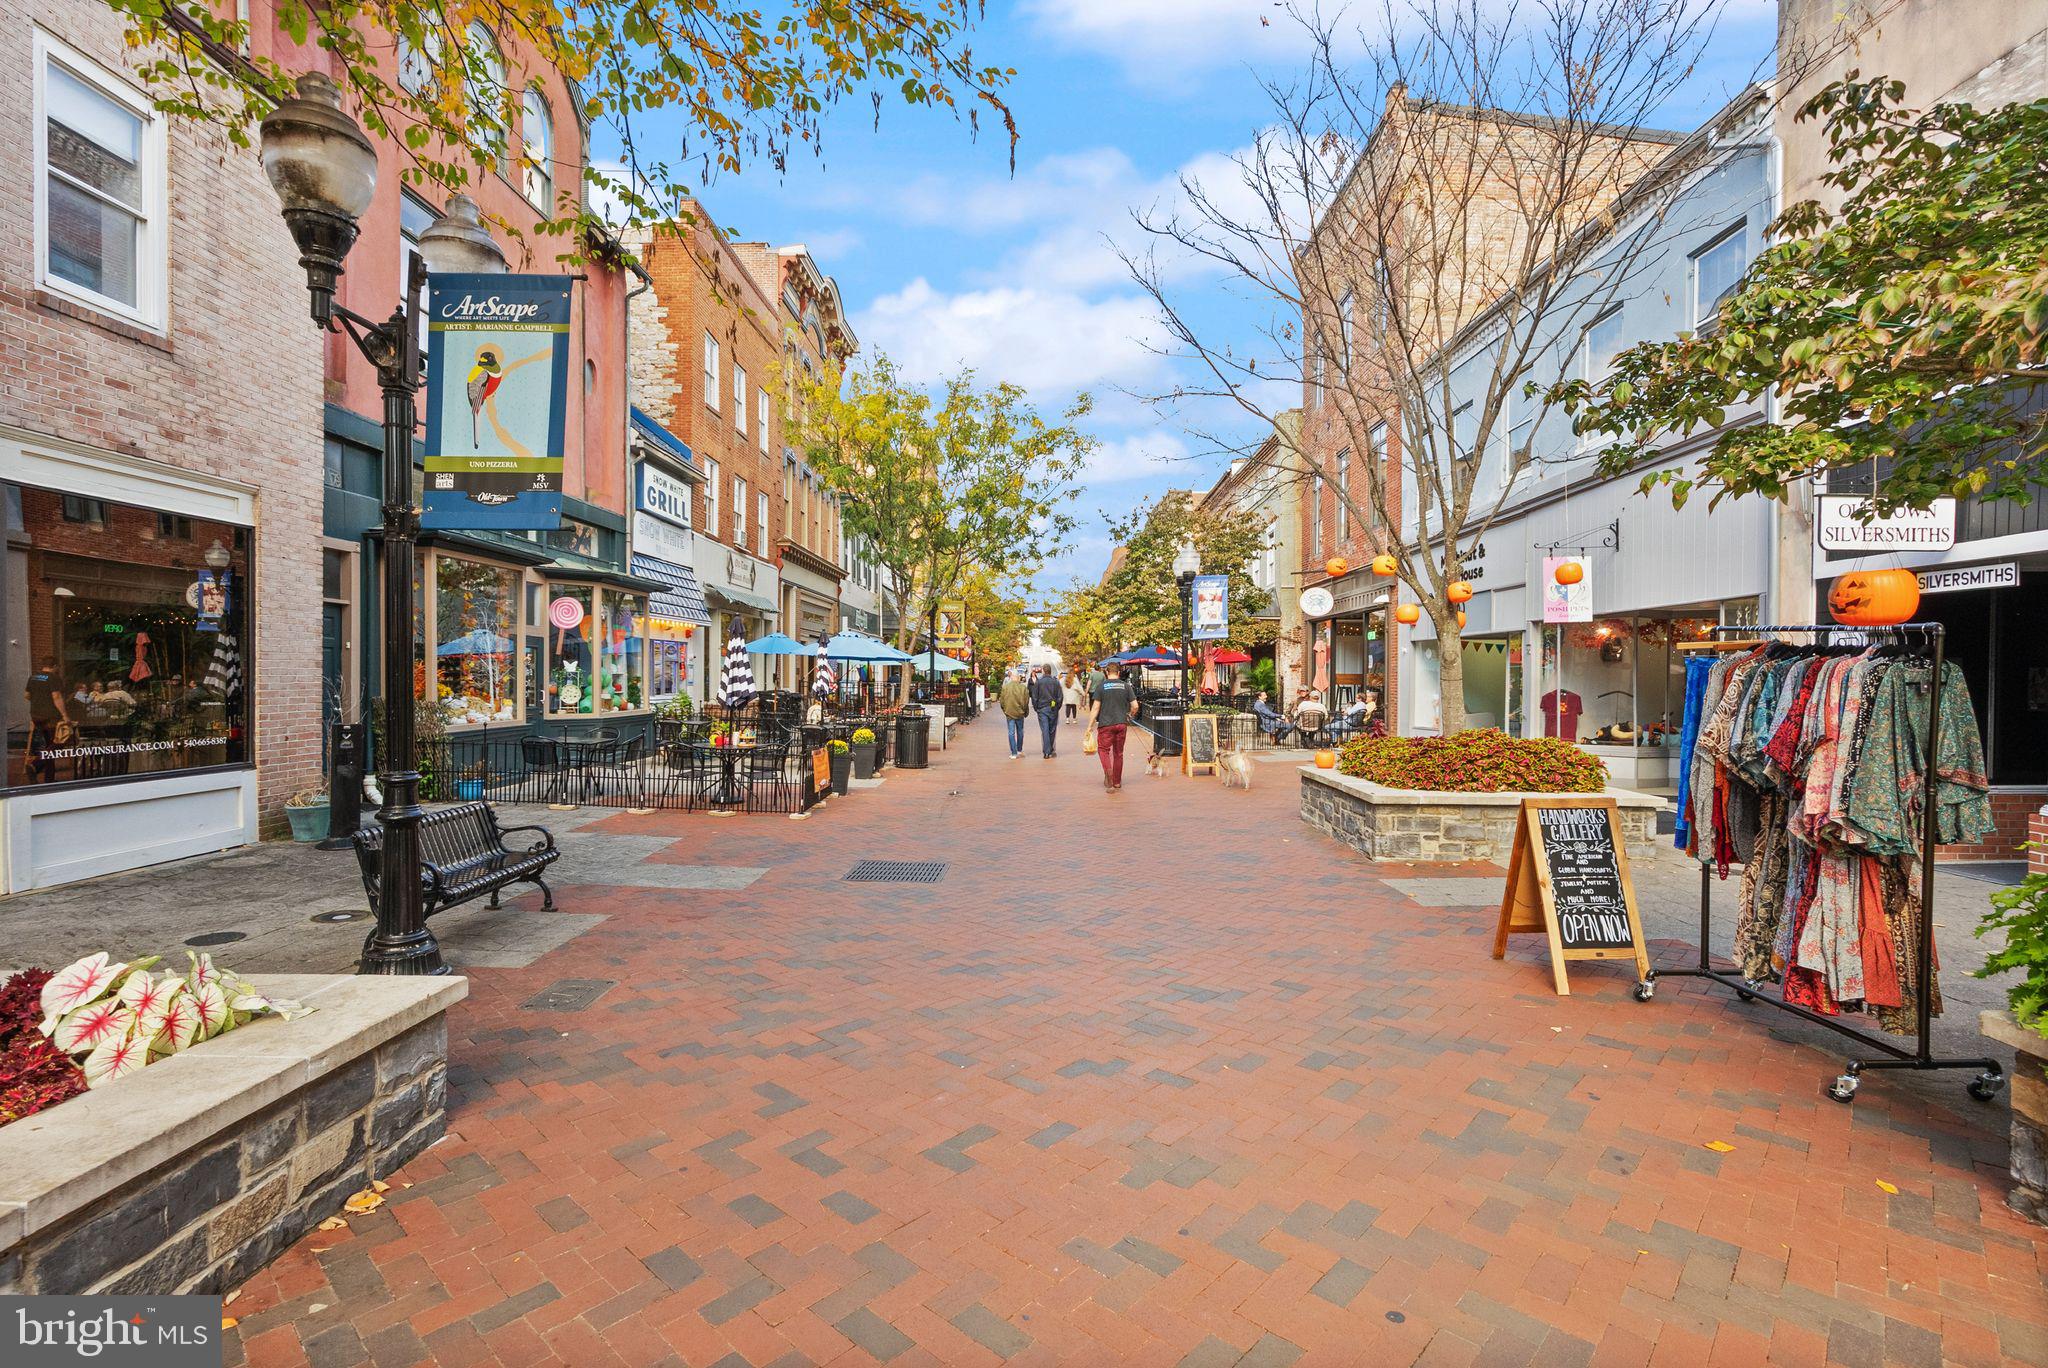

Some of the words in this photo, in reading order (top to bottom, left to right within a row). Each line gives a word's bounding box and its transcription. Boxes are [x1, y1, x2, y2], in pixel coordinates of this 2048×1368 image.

[442, 294, 539, 322] ArtScape
[444, 323, 472, 331] ARTIST:
[514, 324, 554, 332] CAMPBELL
[486, 461, 518, 469] PIZZERIA
[653, 474, 667, 489] SNOW
[669, 483, 684, 497] WHITE
[647, 485, 689, 522] GRILL
[1825, 526, 1950, 543] SILVERSMITHS
[1478, 543, 1486, 559] &
[1918, 567, 2014, 590] SILVERSMITHS
[40, 740, 175, 760] PARTLOWINSURANCE.COM
[1538, 808, 1606, 826] HANDWORKS
[1550, 823, 1604, 841] GALLERY
[1567, 895, 1585, 903] MUCH
[1589, 895, 1611, 903] MORE!
[1562, 913, 1602, 943] OPEN
[1599, 914, 1632, 943] NOW
